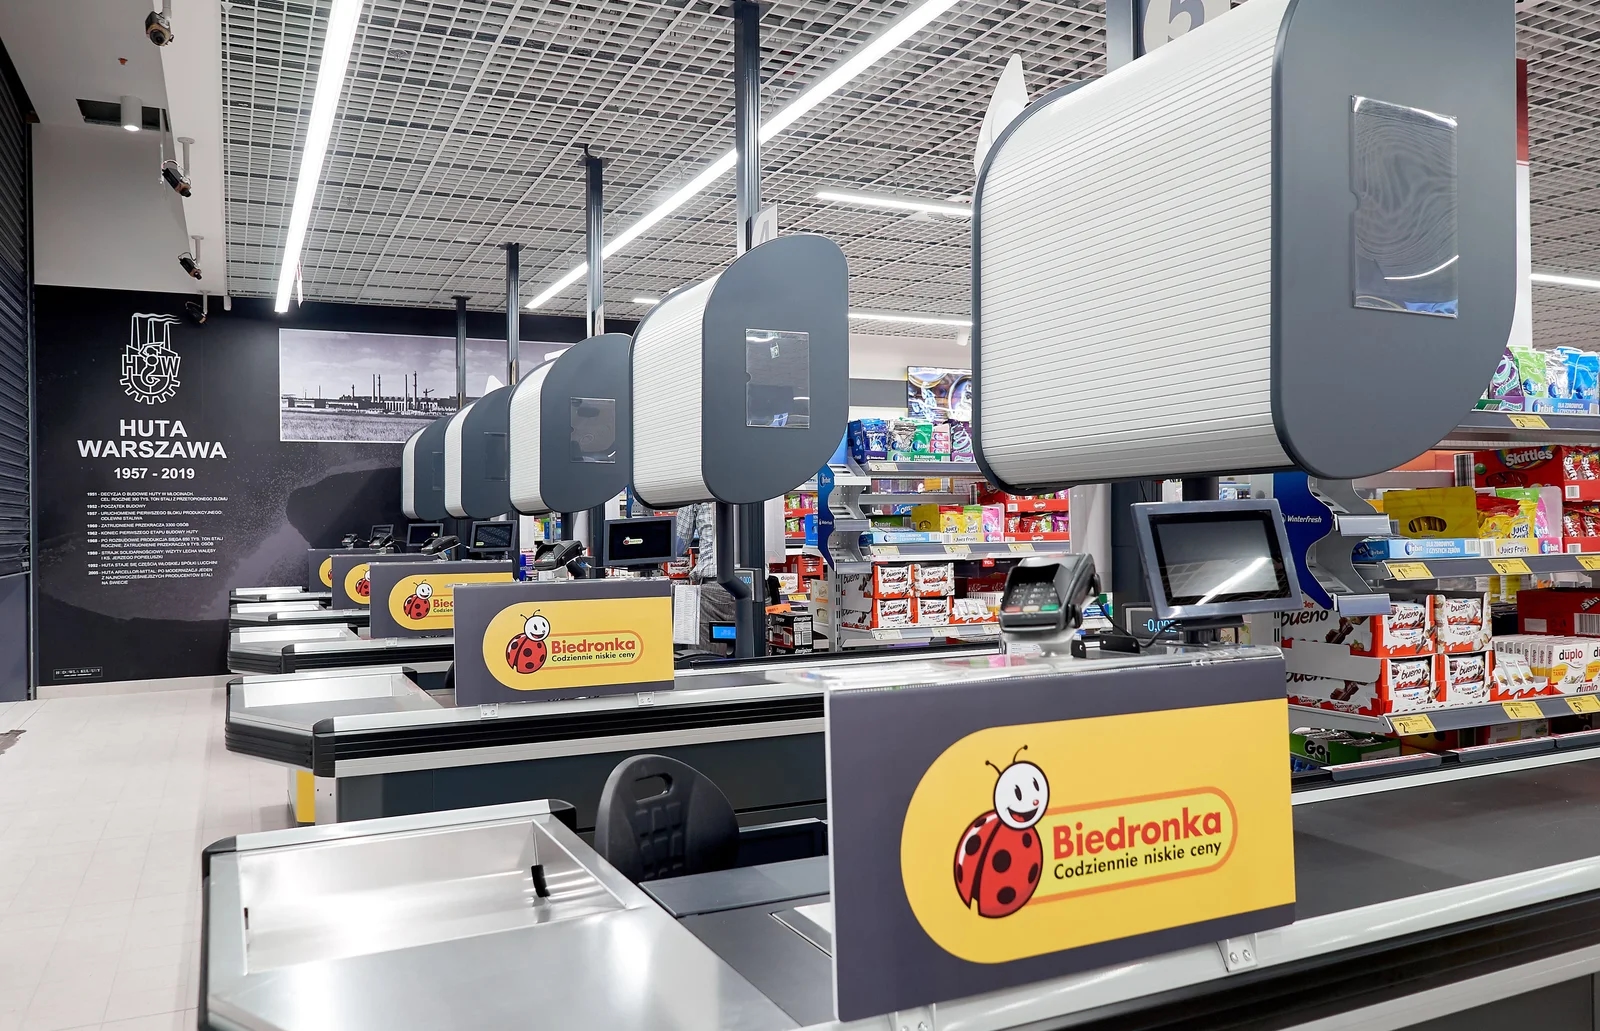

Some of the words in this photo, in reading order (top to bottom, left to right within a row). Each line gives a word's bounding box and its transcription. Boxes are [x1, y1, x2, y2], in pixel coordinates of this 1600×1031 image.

[120, 419, 188, 438] HUTA
[77, 440, 228, 458] WARSZAWA
[1505, 449, 1554, 467] Skittles
[114, 468, 148, 480] 1957
[161, 468, 195, 480] 2019
[1281, 610, 1329, 626] bueno
[1398, 610, 1419, 620] bueno
[552, 638, 635, 654] Biedronka
[552, 653, 593, 662] Codziennie
[619, 651, 635, 660] ceny
[1559, 649, 1583, 662] duplo
[1401, 668, 1422, 680] bueno
[1460, 664, 1478, 675] bueno
[1399, 722, 1409, 733] 2
[1052, 806, 1222, 860] Biedronka
[1053, 852, 1138, 880] Codziennie
[1144, 843, 1185, 865] niskie
[1190, 841, 1222, 858] ceny
